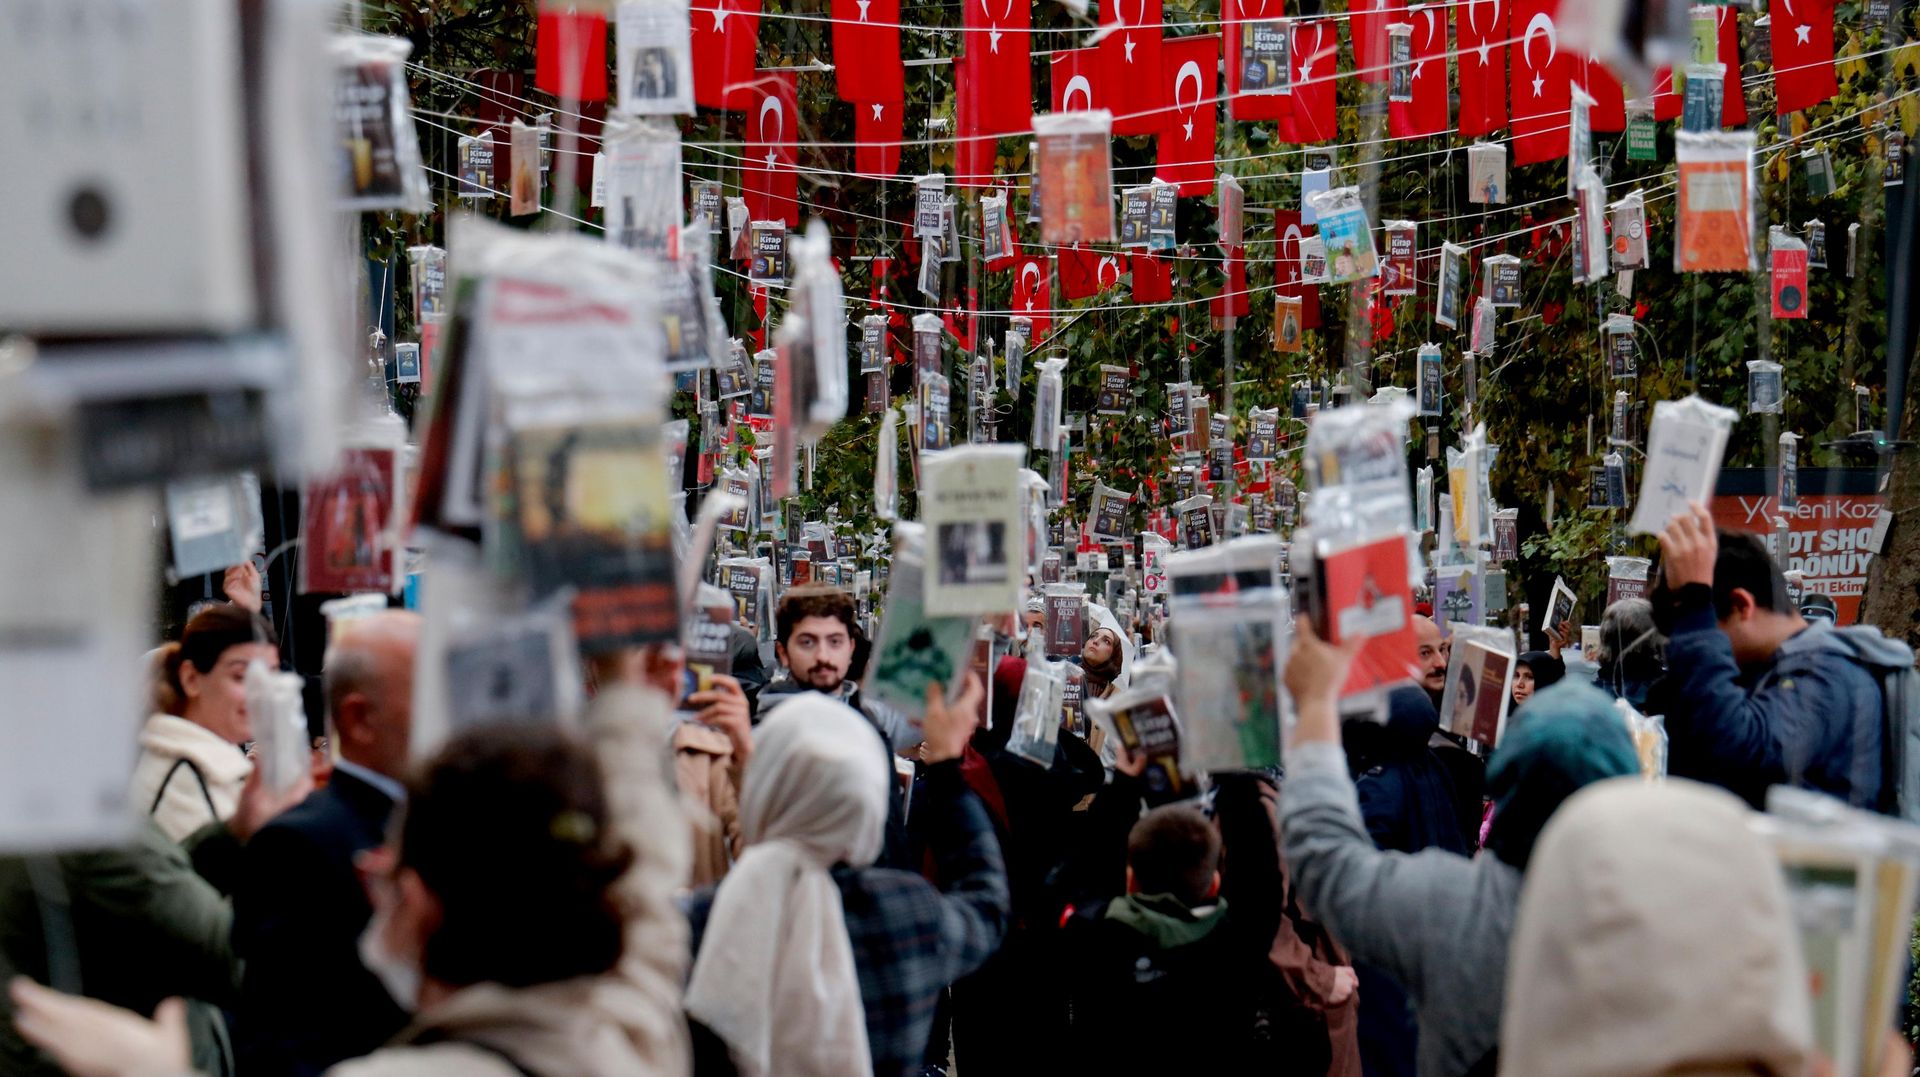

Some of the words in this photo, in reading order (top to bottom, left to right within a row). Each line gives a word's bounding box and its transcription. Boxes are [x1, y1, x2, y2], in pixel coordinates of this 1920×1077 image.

[1254, 32, 1285, 43] Kitap
[1254, 42, 1283, 51] Fuarı
[470, 150, 493, 159] Kitap
[1156, 189, 1175, 198] Kitap
[1129, 200, 1147, 210] Kitap
[1392, 239, 1411, 249] Kitap
[1392, 247, 1410, 255] Fuarı
[1107, 377, 1126, 385] Kitap
[728, 486, 748, 496] Kitap
[1107, 501, 1125, 510] Kitap
[1836, 500, 1885, 519] Koz
[1106, 507, 1122, 515] Fuarı
[1190, 513, 1206, 522] Kitap
[731, 575, 756, 584] Kitap
[731, 582, 754, 591] Fuarı
[1830, 582, 1864, 593] Ekim
[1063, 683, 1081, 695] itap
